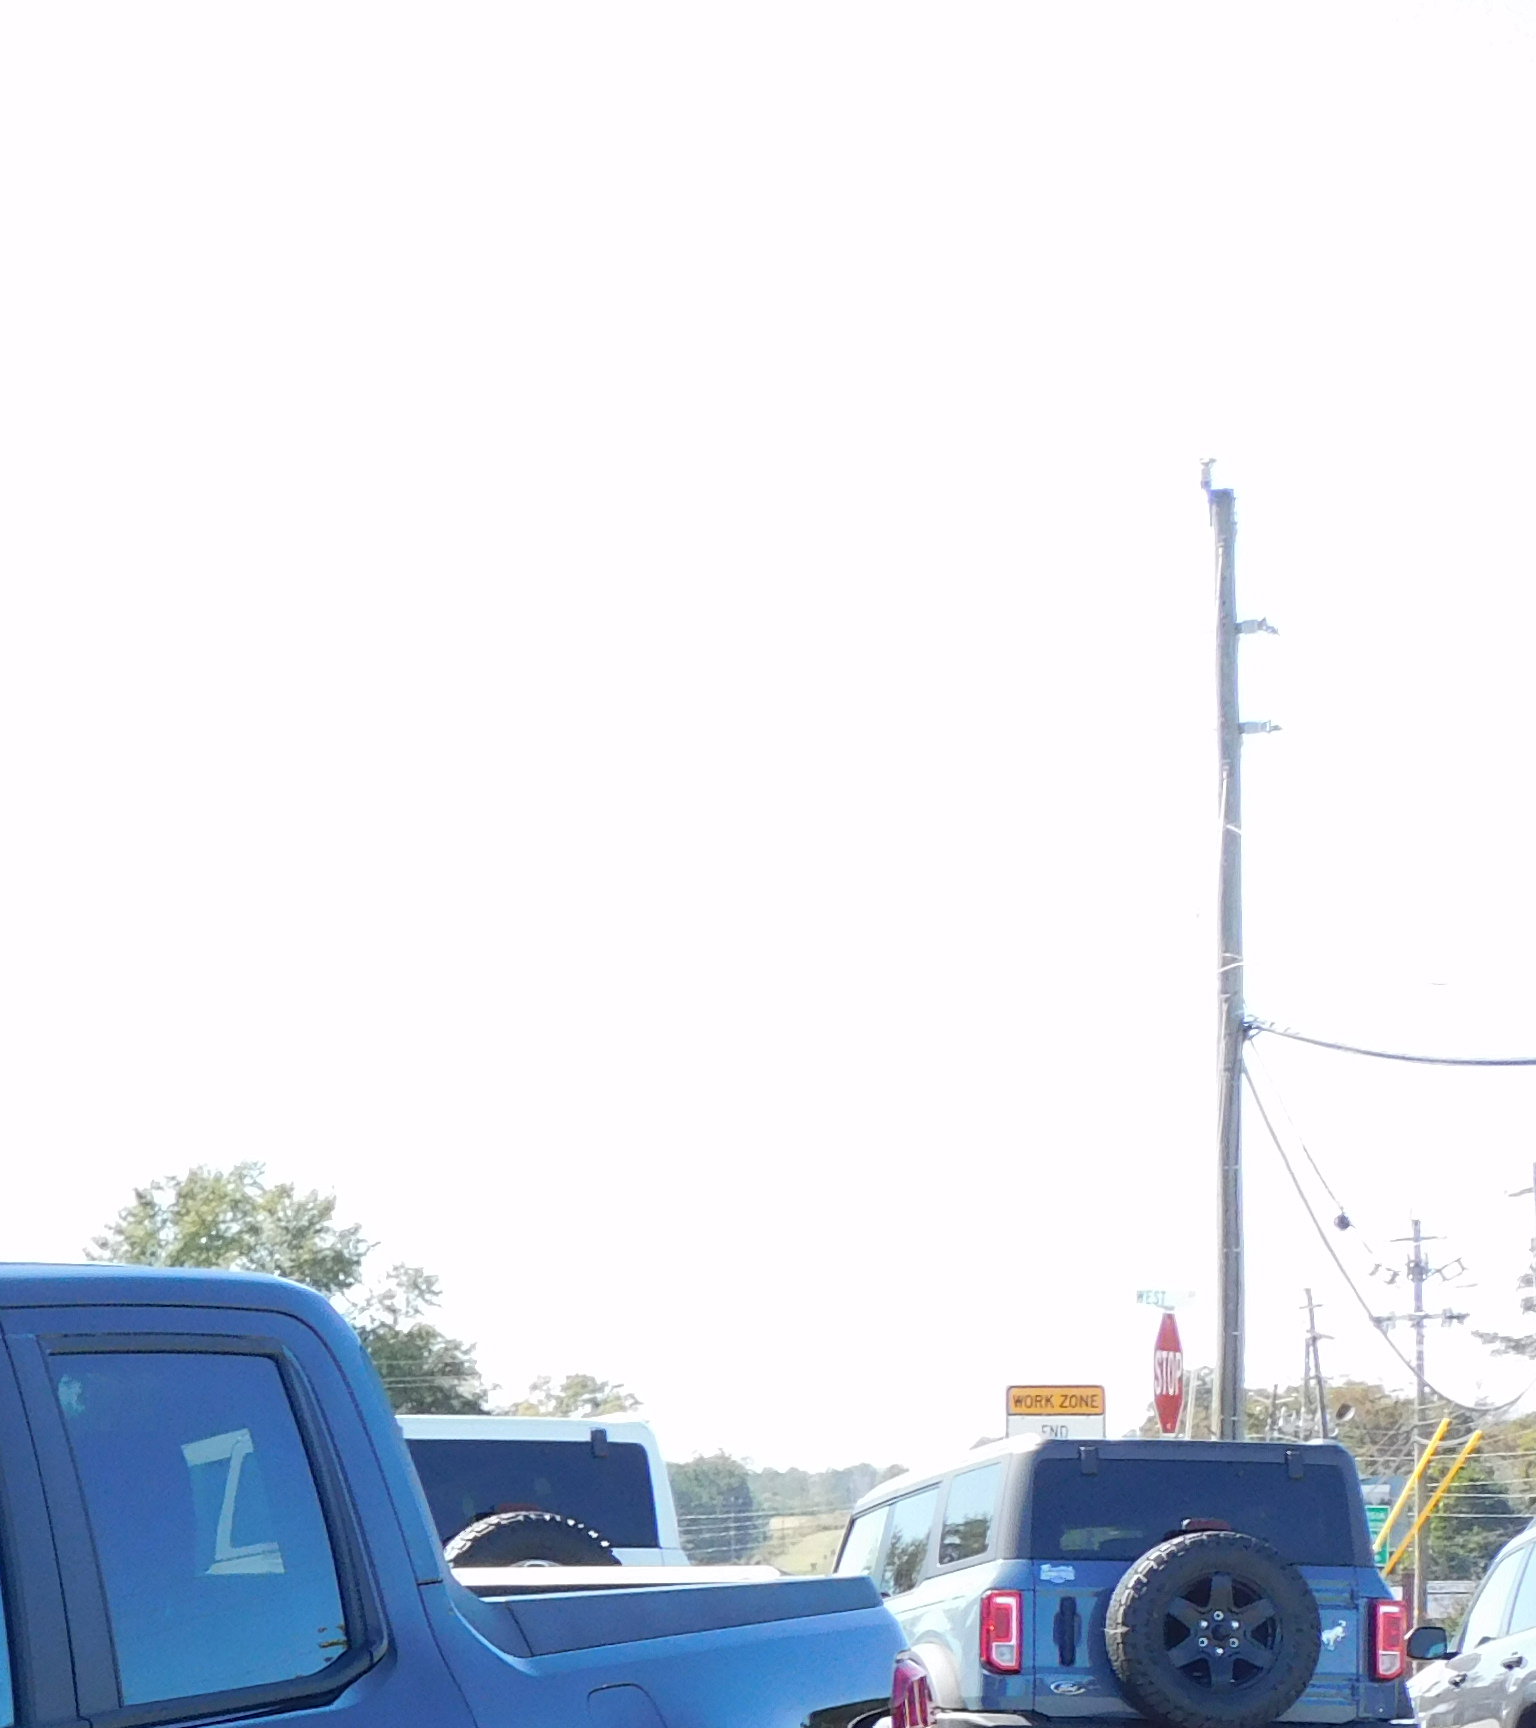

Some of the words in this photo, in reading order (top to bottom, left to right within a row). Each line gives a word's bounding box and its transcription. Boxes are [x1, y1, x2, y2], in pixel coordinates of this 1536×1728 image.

[1154, 1350, 1183, 1396] STOP
[1013, 1395, 1054, 1409] WORK
[1059, 1395, 1099, 1409] ZONE
